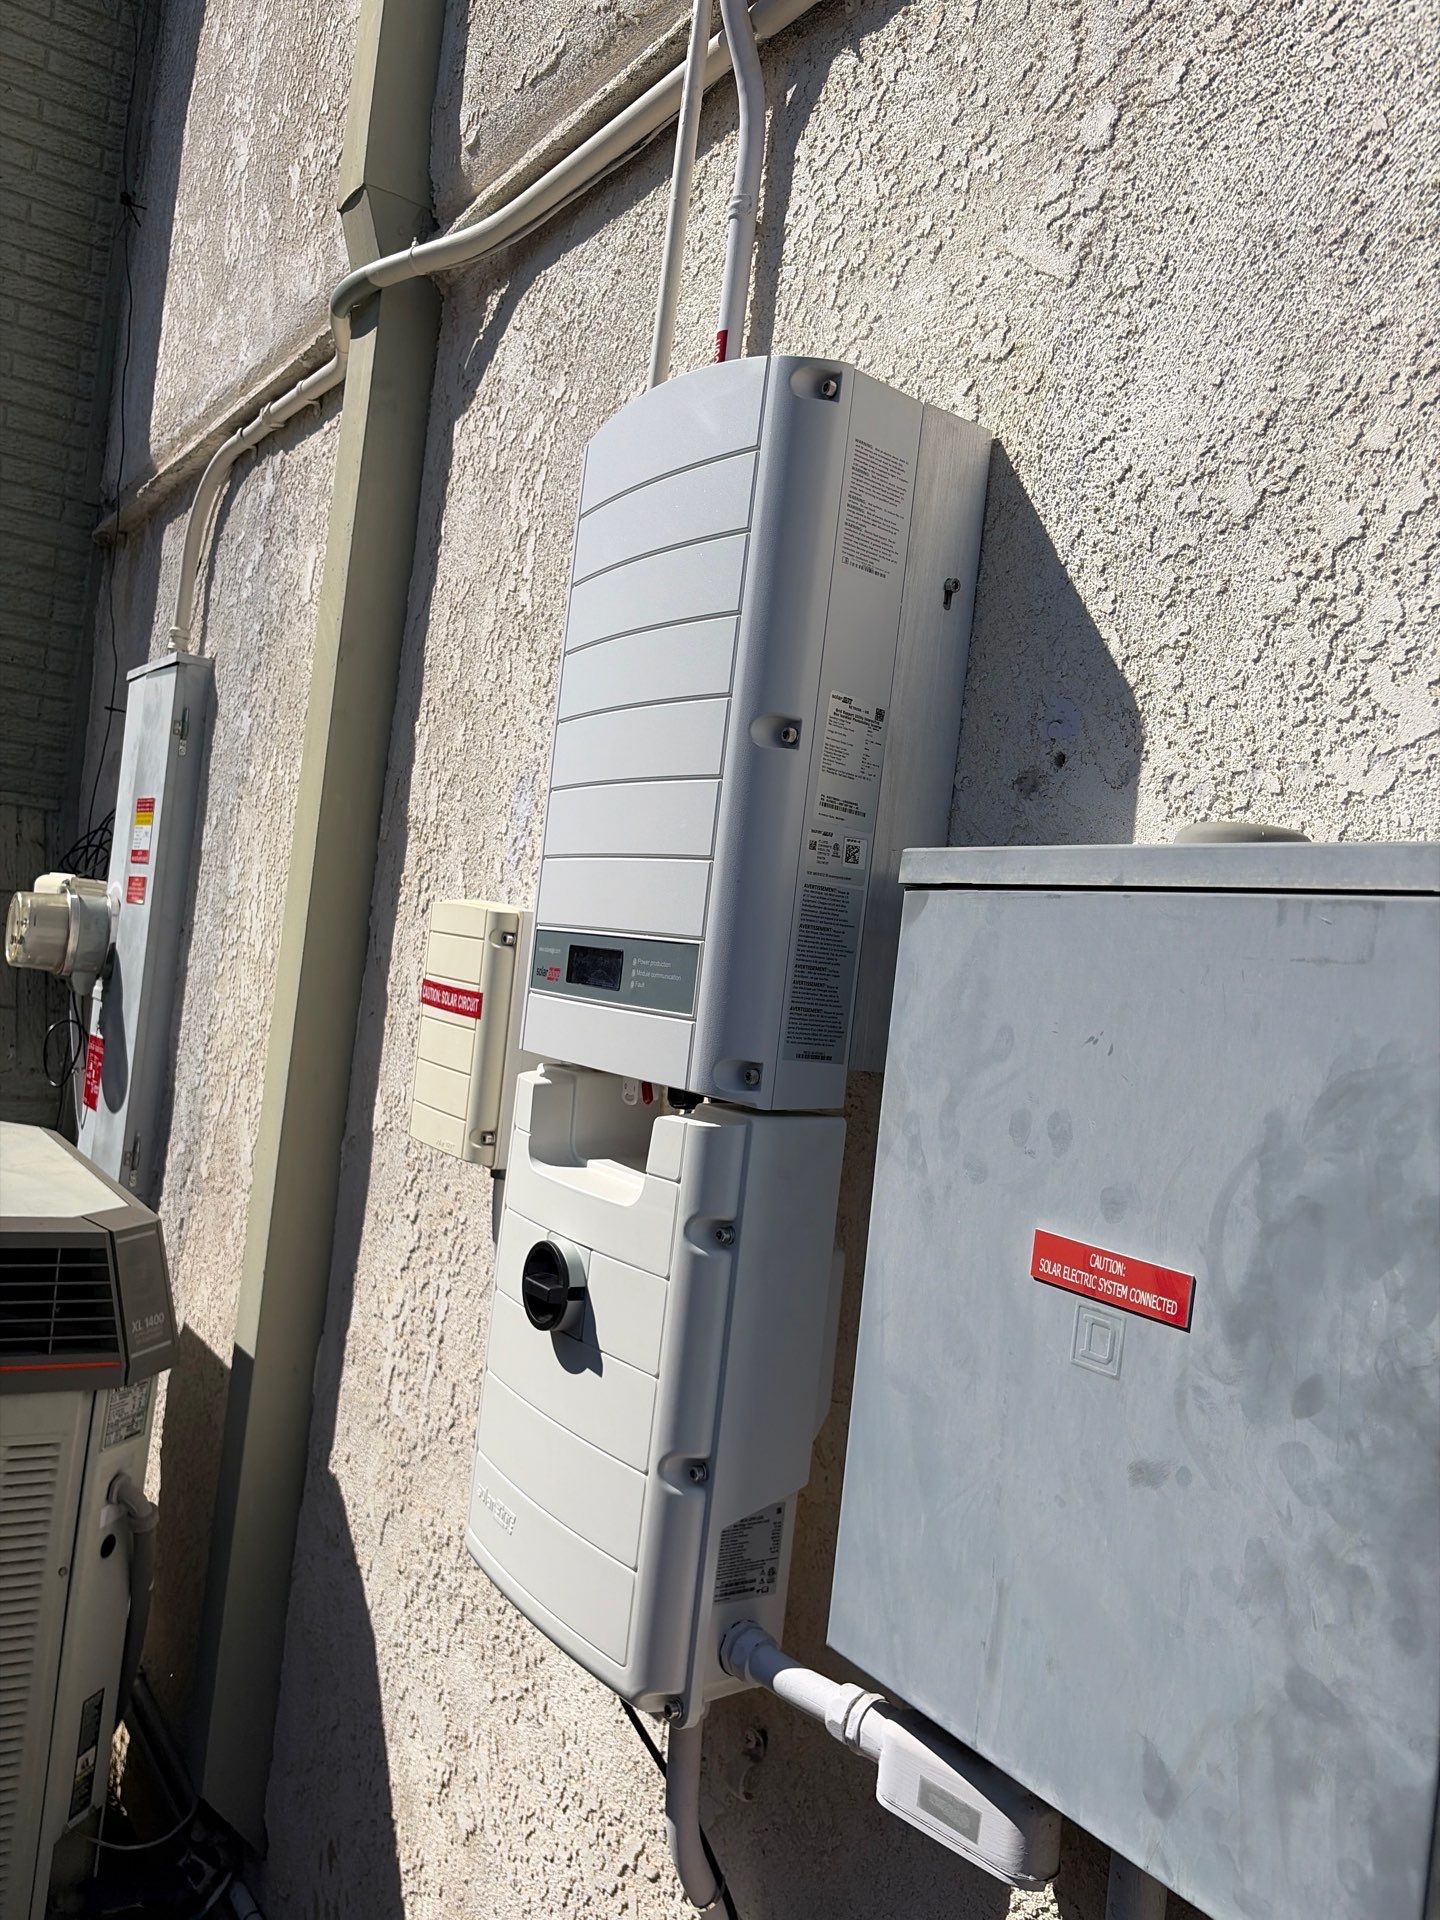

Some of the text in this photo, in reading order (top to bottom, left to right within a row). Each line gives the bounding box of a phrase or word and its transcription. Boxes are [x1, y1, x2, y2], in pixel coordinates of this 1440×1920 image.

[442, 990, 458, 1007] SOLAR
[458, 994, 480, 1012] CIRCUIT
[1089, 1253, 1126, 1277] CAUTION:
[1039, 1258, 1178, 1316] SOLAR ELECTRIC SYSTEM CONNECTED
[132, 1312, 163, 1332] XL 1400
